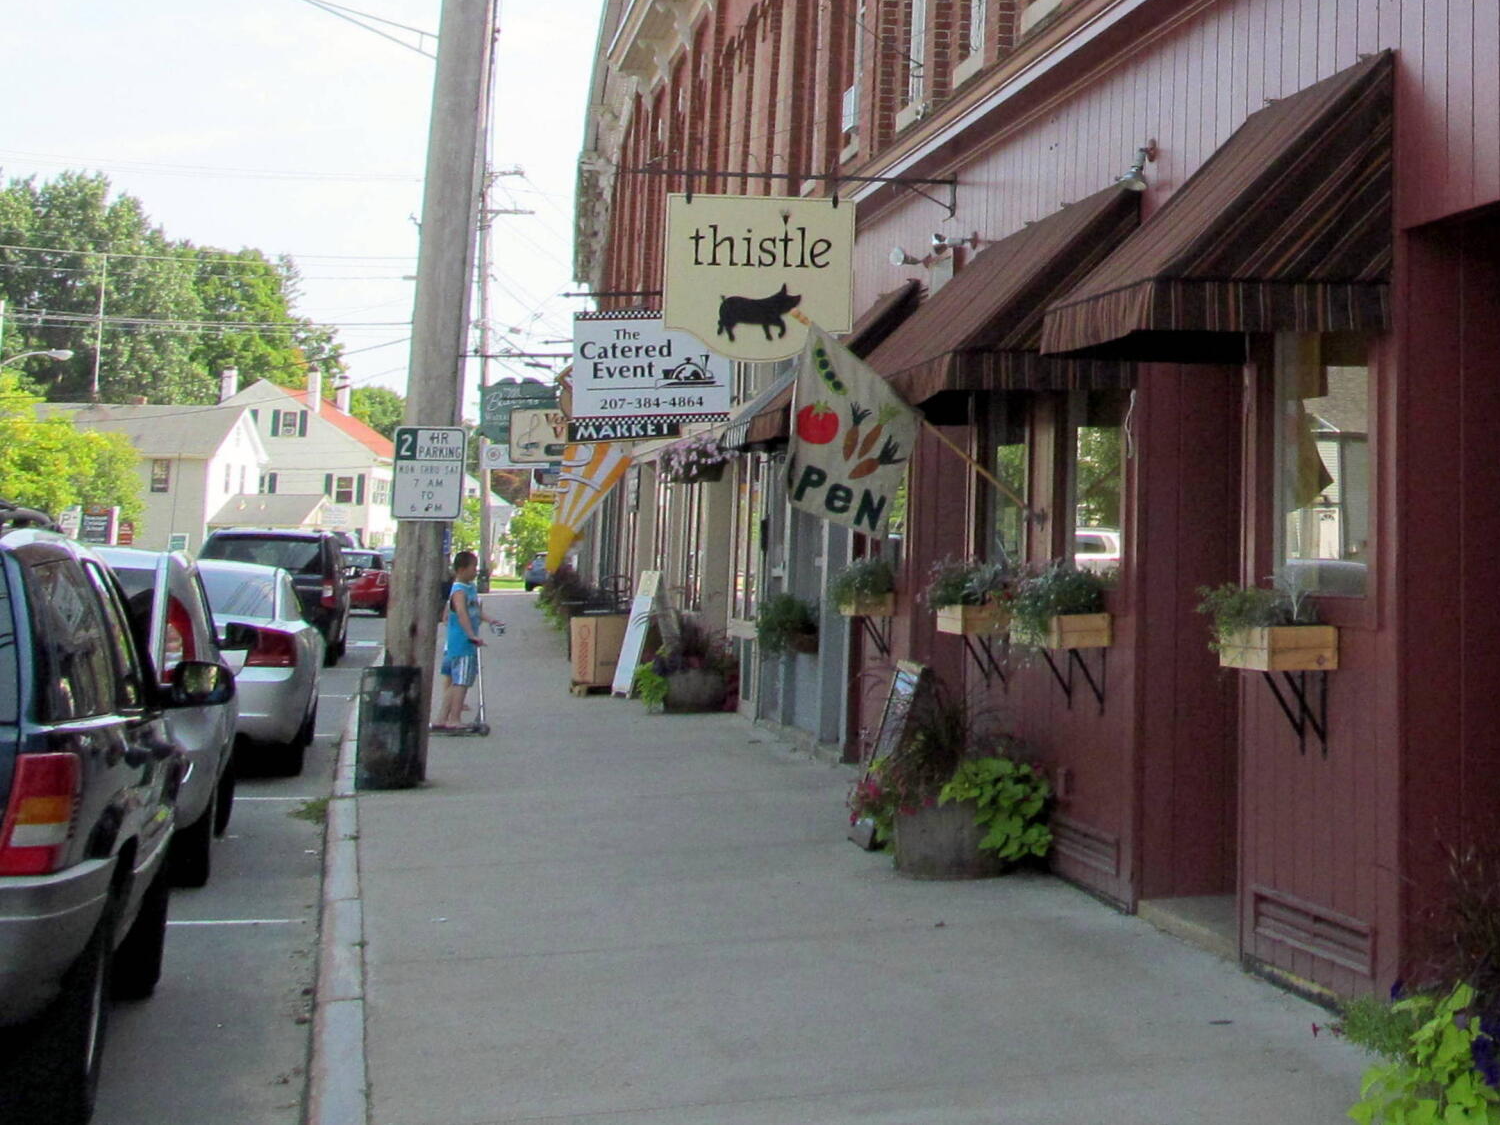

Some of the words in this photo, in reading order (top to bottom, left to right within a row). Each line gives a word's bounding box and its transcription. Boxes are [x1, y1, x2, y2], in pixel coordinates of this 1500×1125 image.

[690, 212, 833, 269] thistle
[614, 328, 641, 340] The
[580, 339, 672, 360] Catered
[593, 361, 655, 379] Event
[600, 396, 704, 410] 207-384-4864
[400, 434, 413, 455] 2
[431, 432, 449, 444] HR
[418, 446, 462, 458] PARKING
[398, 465, 414, 474] MON
[421, 465, 440, 474] THRU
[445, 465, 459, 474] SAT
[413, 478, 419, 487] 7
[427, 478, 443, 487] AM
[421, 490, 434, 500] TO
[410, 503, 417, 512] 6
[427, 503, 443, 512] PM
